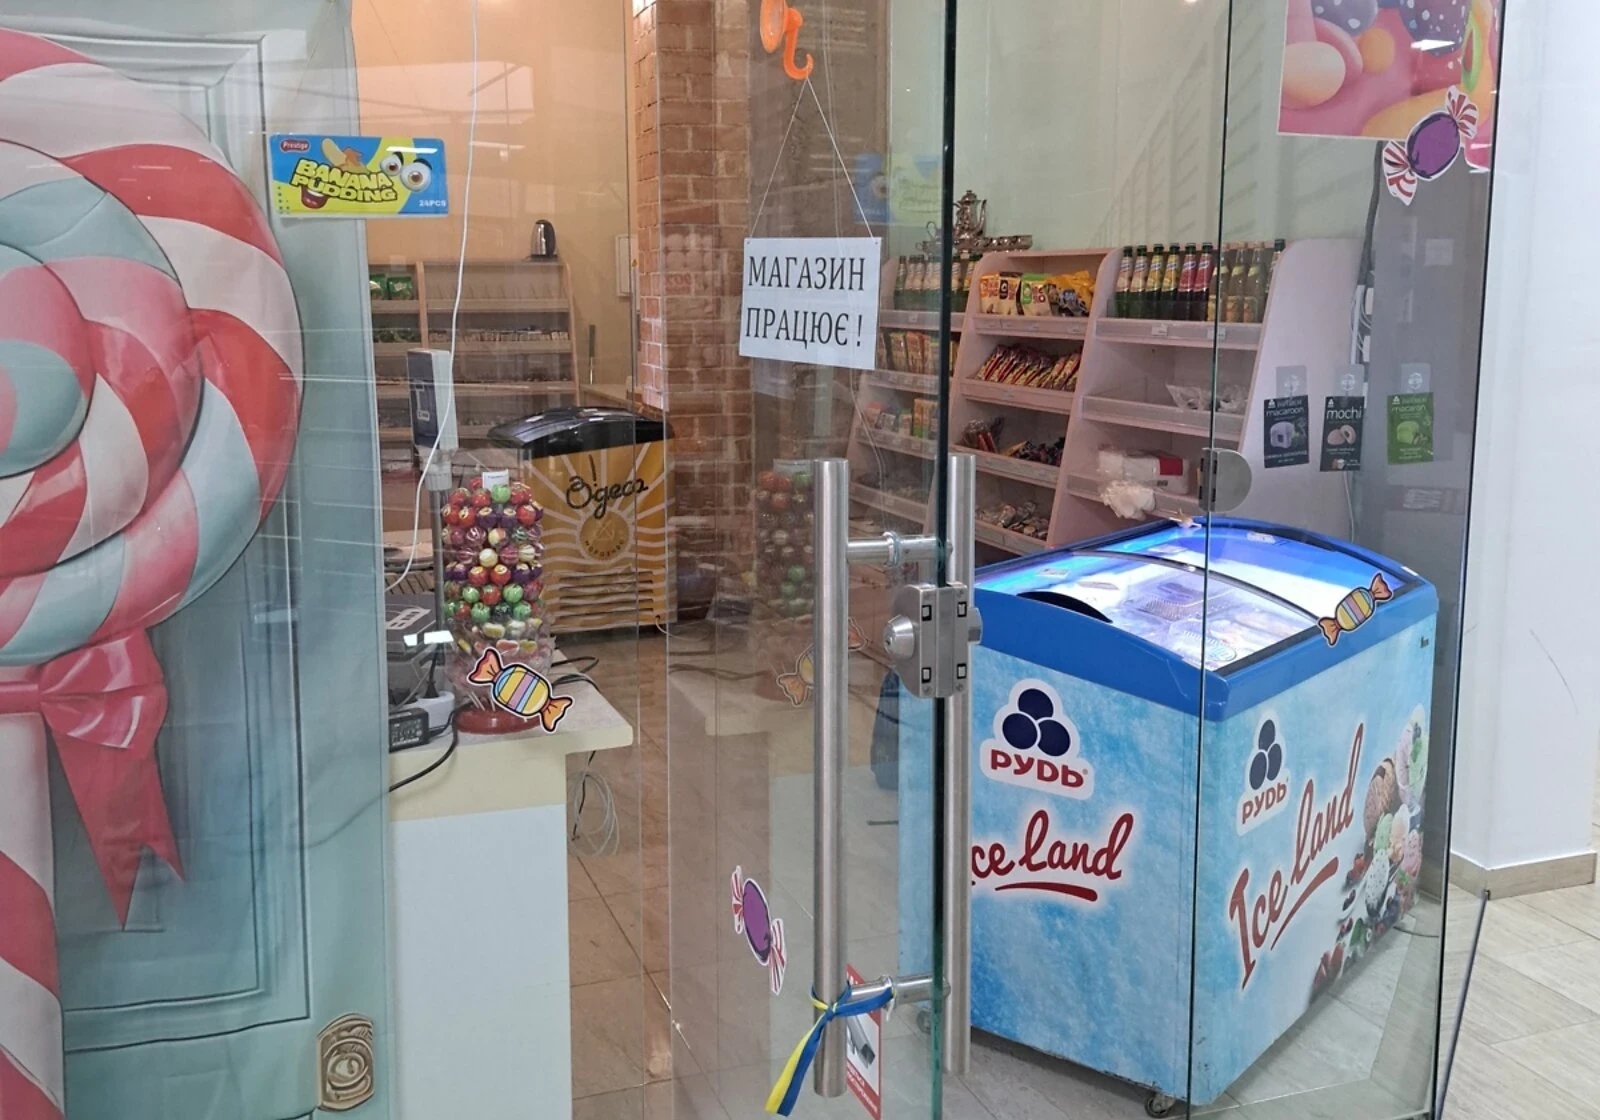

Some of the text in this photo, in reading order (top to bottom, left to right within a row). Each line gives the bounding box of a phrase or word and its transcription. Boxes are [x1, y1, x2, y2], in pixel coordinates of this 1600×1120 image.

[289, 174, 397, 202] PUDDING
[295, 157, 394, 191] BANANA
[748, 256, 865, 291] МАГАЗИН
[1326, 406, 1362, 420] mochi
[971, 809, 1134, 880] ce land
[1229, 722, 1364, 990] Ice land
